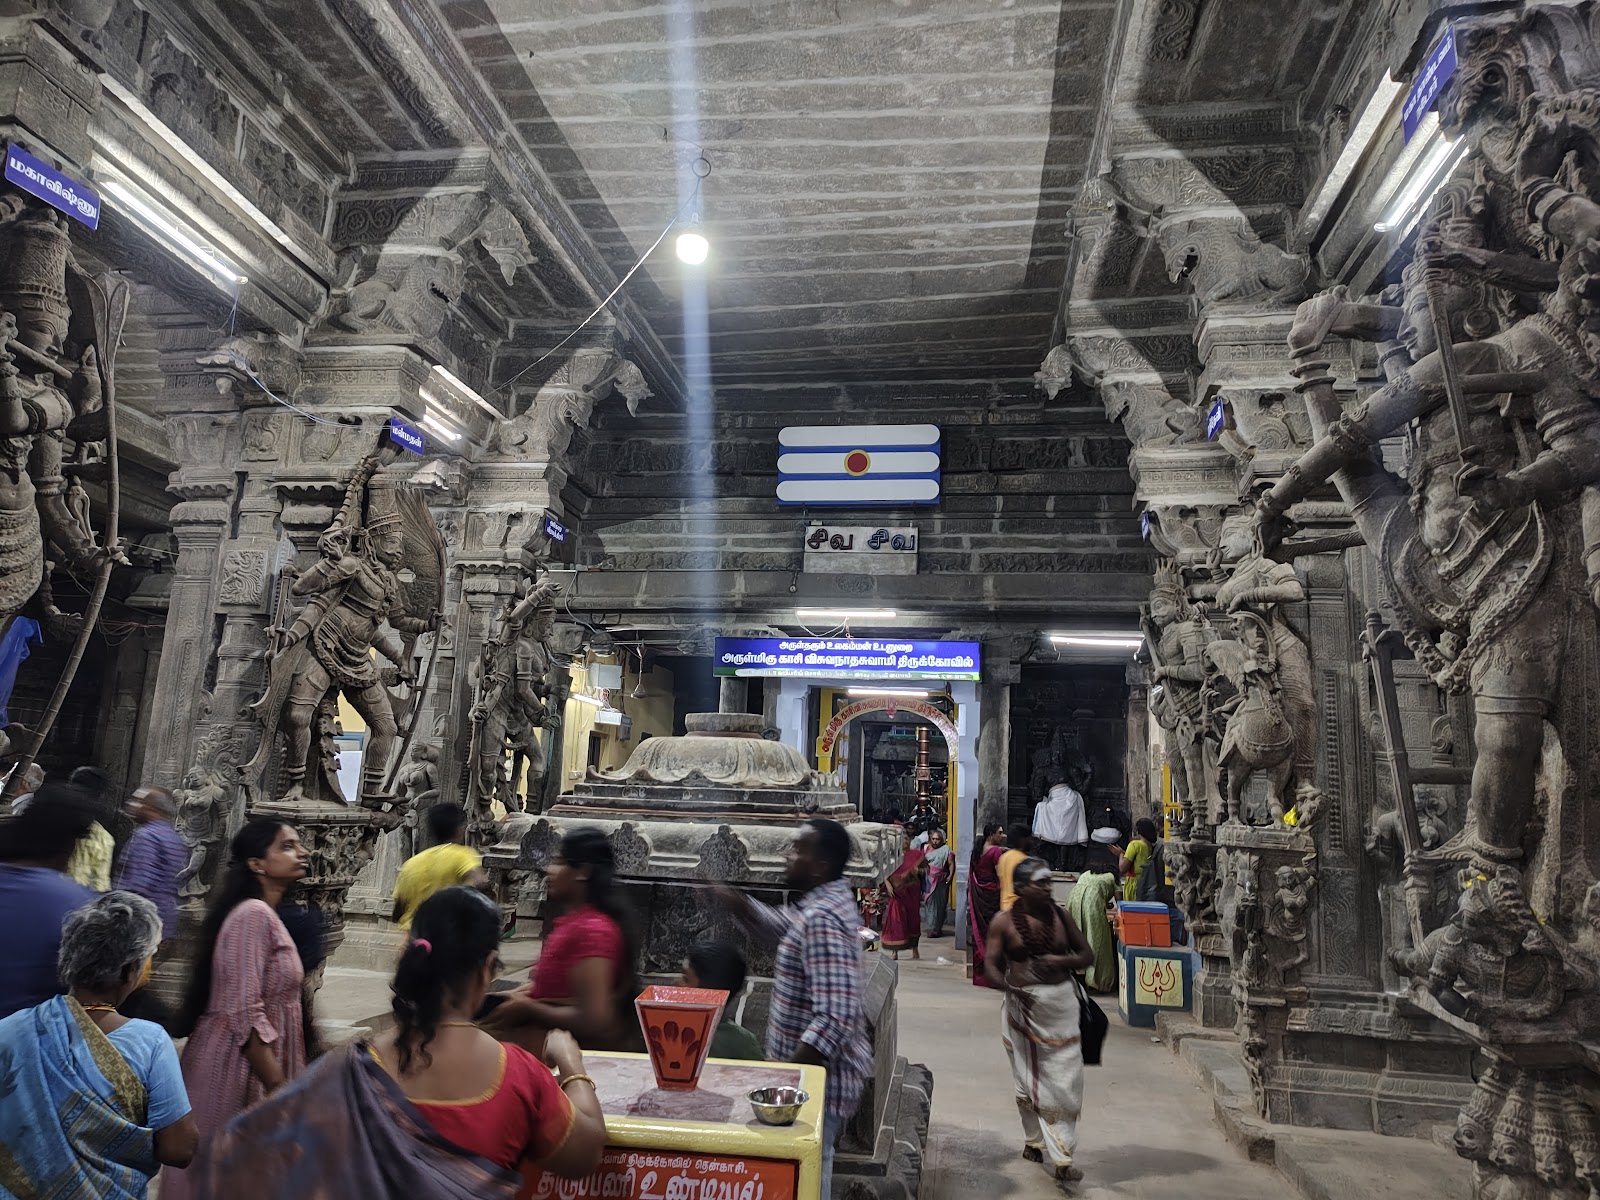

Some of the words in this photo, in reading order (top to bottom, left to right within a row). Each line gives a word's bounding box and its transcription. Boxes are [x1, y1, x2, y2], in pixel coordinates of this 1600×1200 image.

[9, 156, 98, 219] மகாவிஷ்ணு
[807, 528, 854, 551] சிவ
[867, 528, 916, 551] சிவ
[779, 640, 826, 651] அருள்தரும்
[826, 641, 873, 651] உலகம்மன்
[873, 642, 914, 654] உடனுறை
[721, 652, 778, 665] அருள்மிகு
[778, 652, 803, 665] காசி
[804, 653, 897, 668] விசுவநாதசுவாமி
[897, 655, 974, 669] திருக்கோவில்
[627, 1153, 692, 1169] திருக்கோவில்
